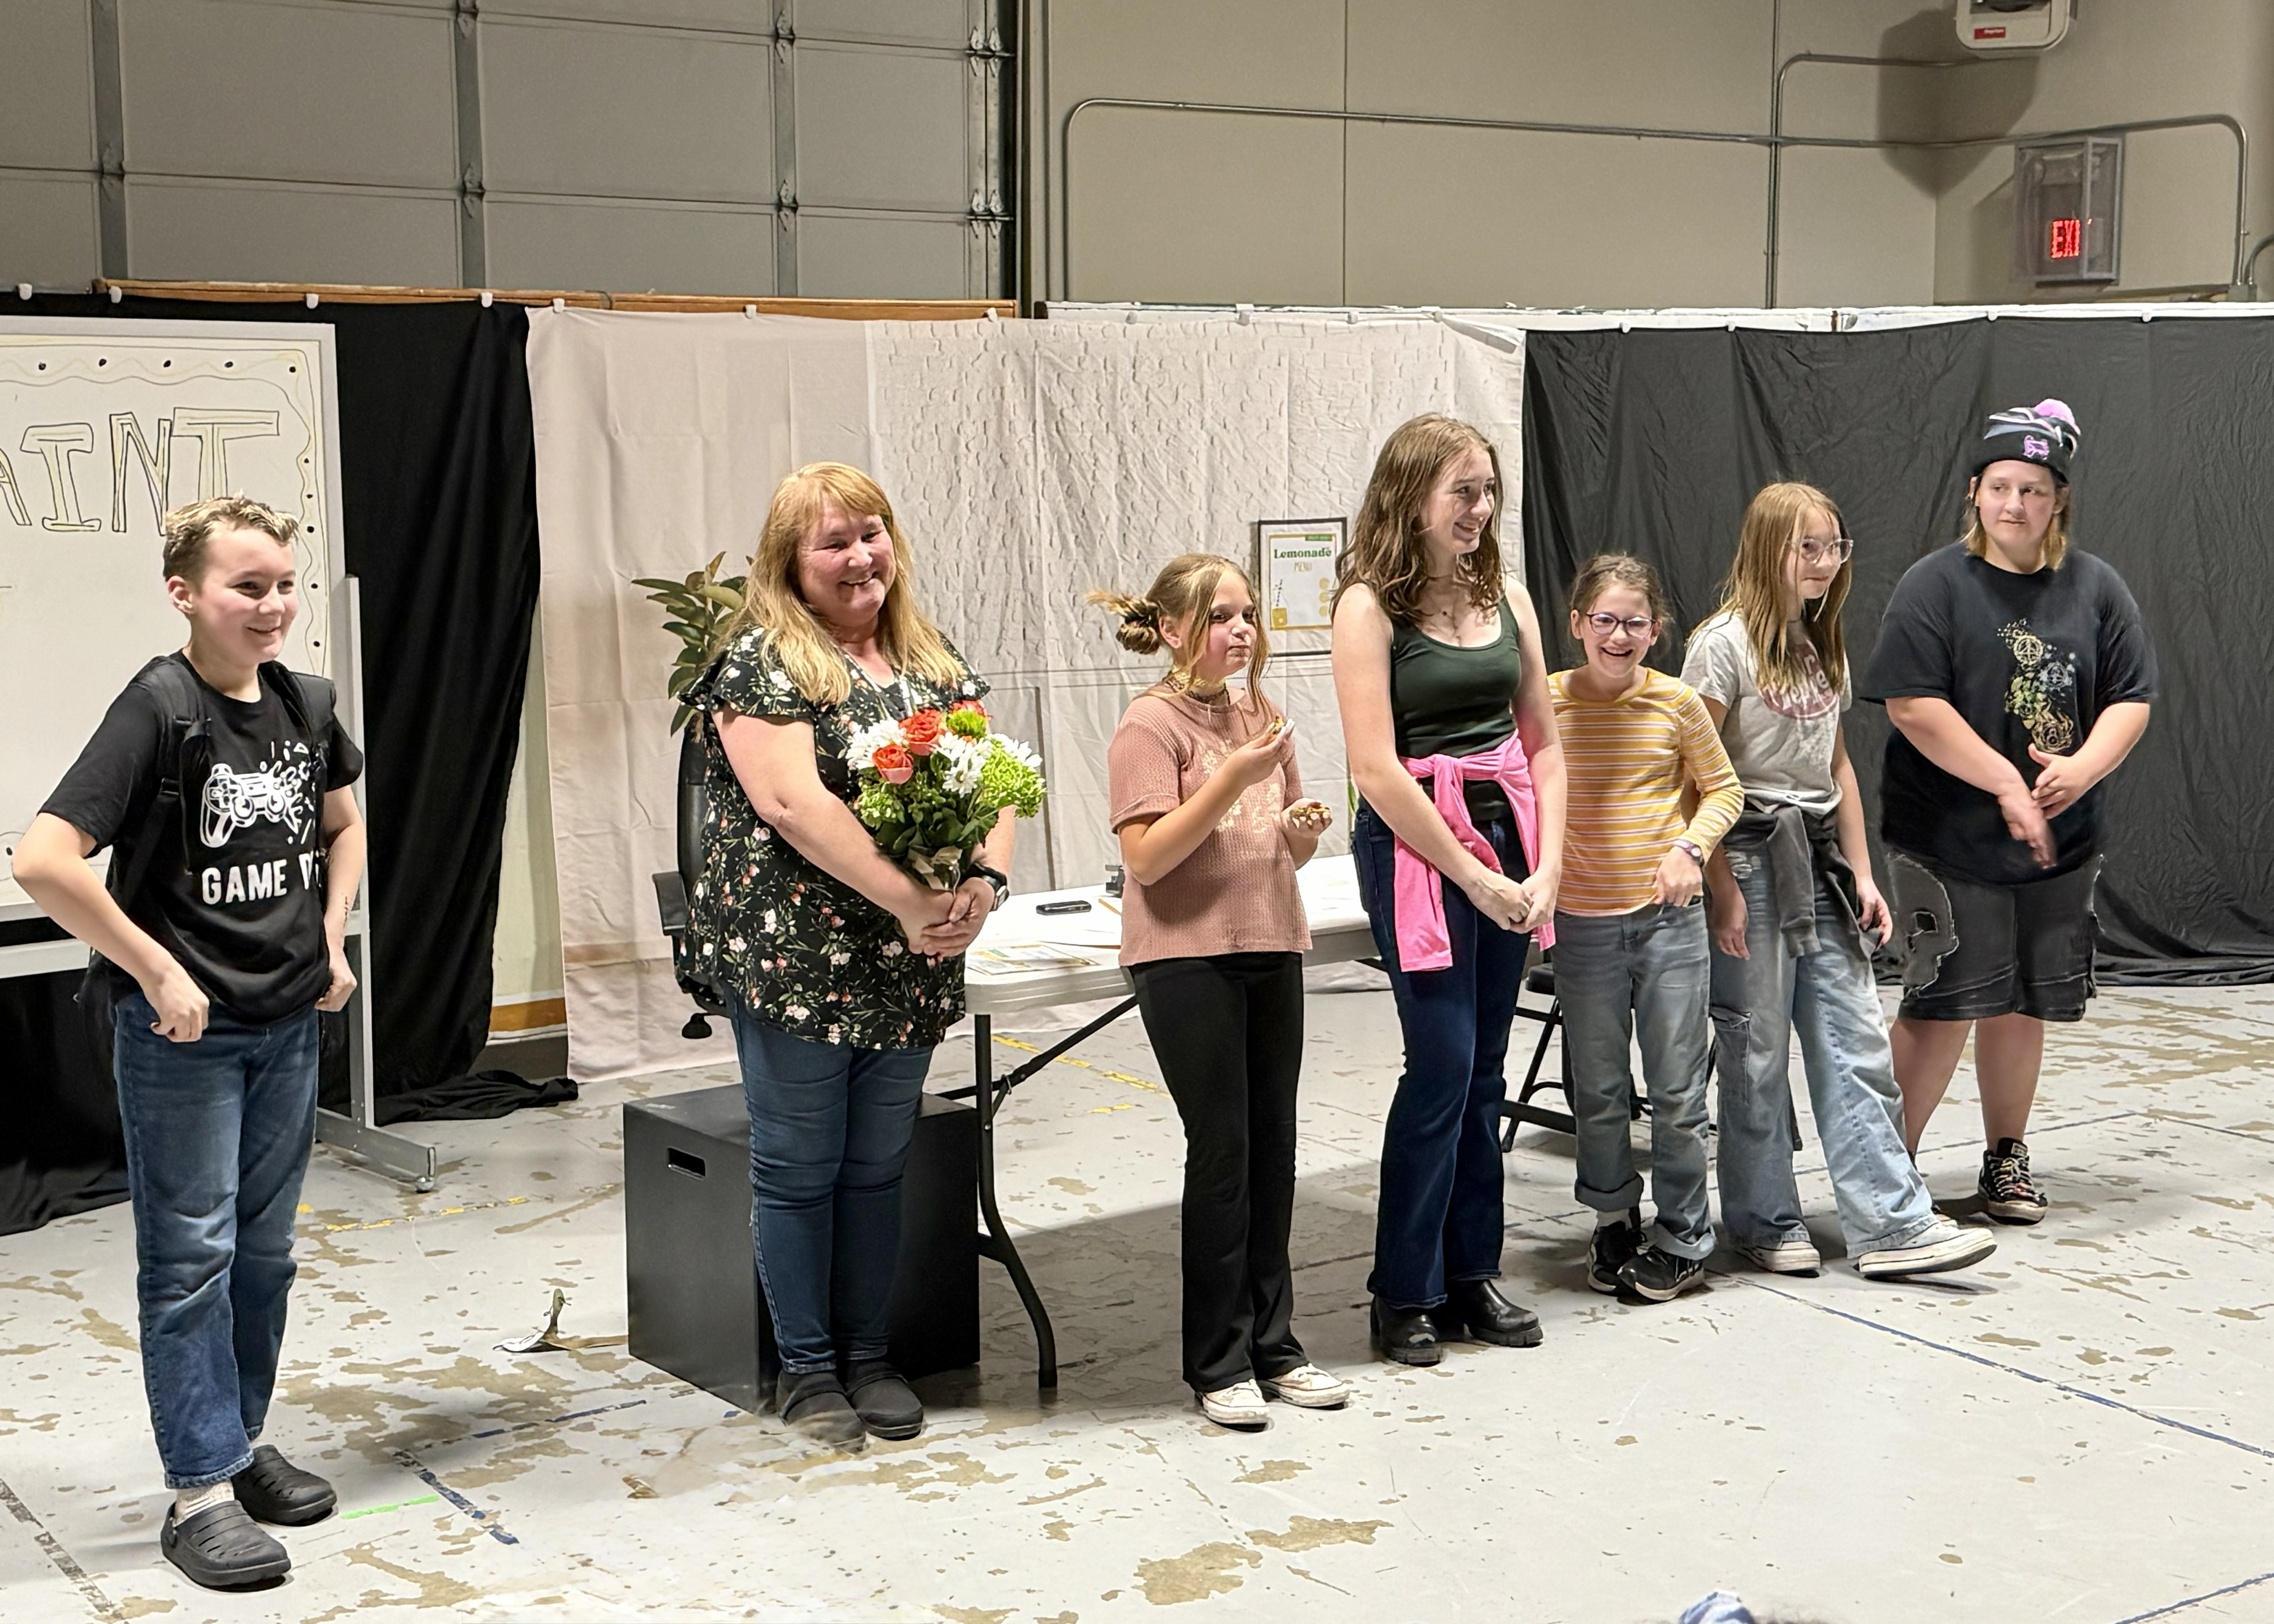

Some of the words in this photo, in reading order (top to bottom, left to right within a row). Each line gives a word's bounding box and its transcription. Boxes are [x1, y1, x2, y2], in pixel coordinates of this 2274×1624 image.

[2051, 219, 2080, 258] EXI
[1274, 547, 1332, 559] Lemonade
[202, 859, 287, 905] GAME
